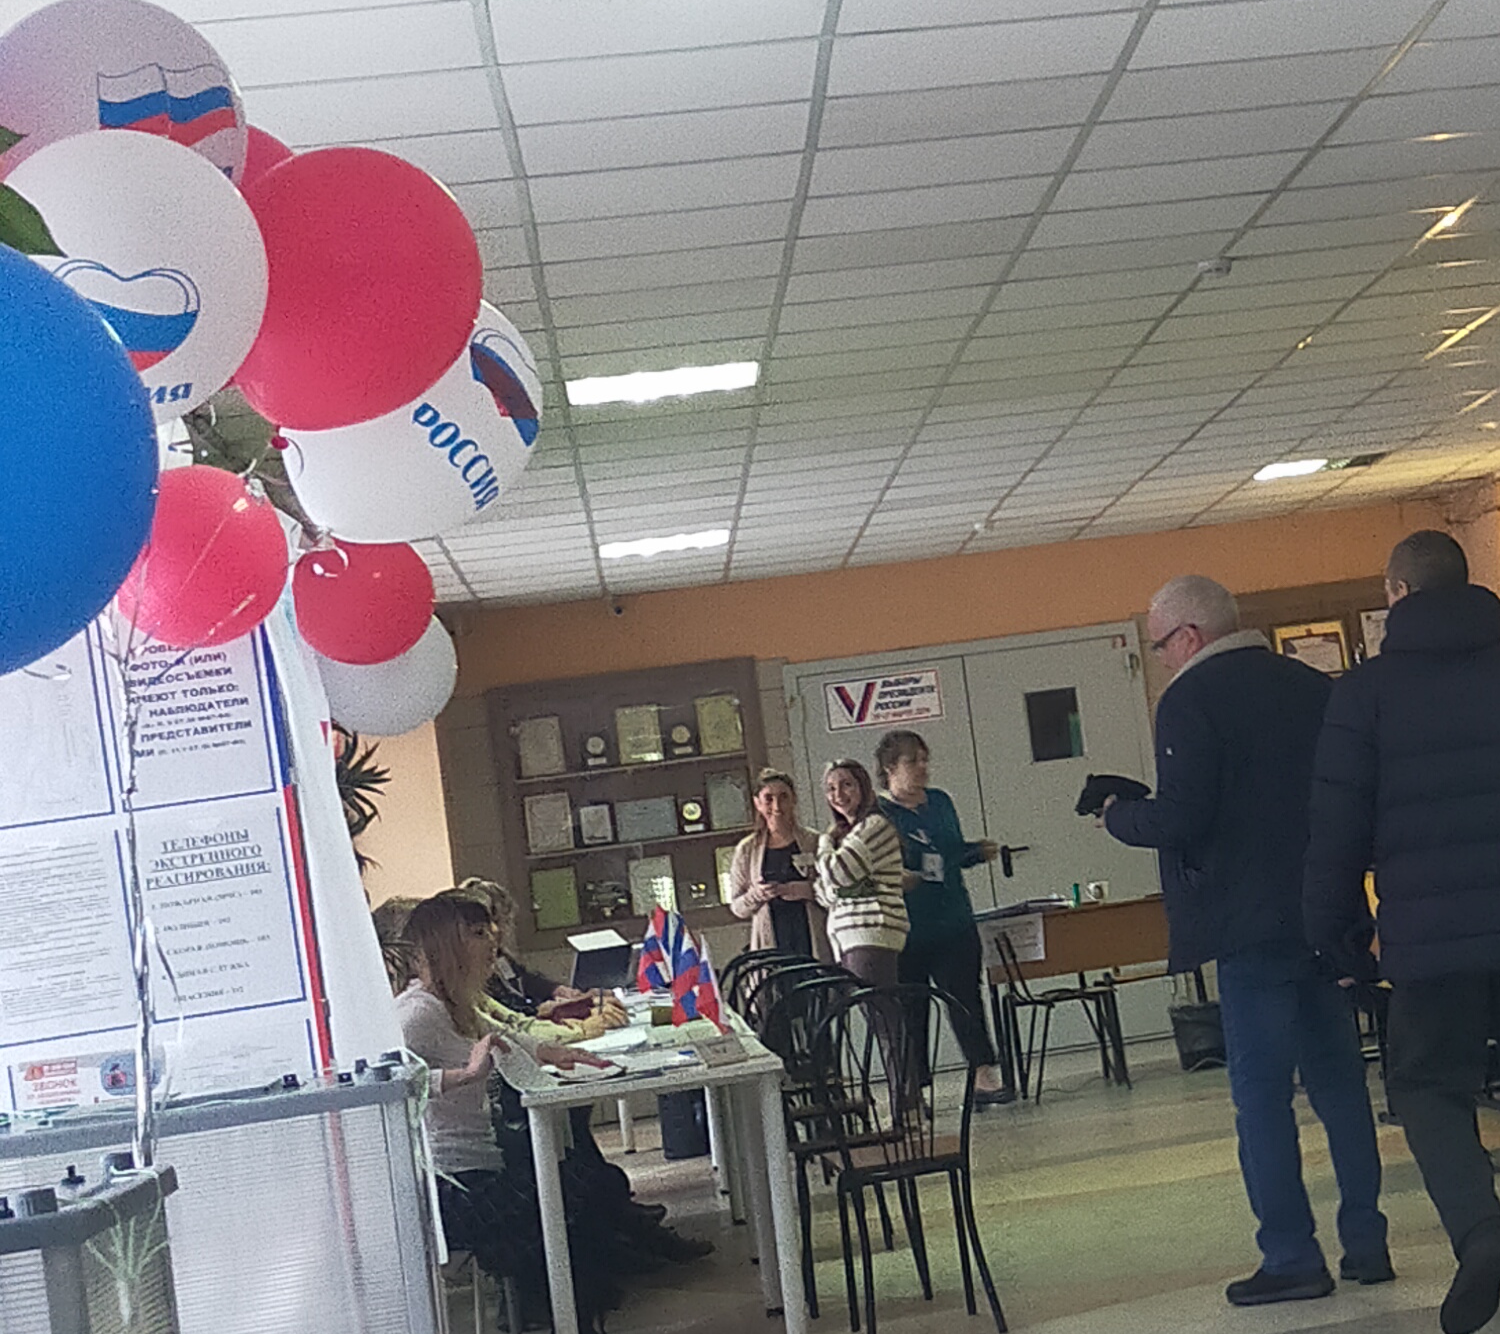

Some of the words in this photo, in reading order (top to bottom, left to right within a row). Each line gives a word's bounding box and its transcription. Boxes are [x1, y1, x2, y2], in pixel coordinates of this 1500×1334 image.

[412, 402, 499, 511] РОССИЯ
[149, 697, 250, 717] НАБЛЮДАТЕЛИ
[141, 719, 252, 742] ПРЕДСТАВИТЕЛИ
